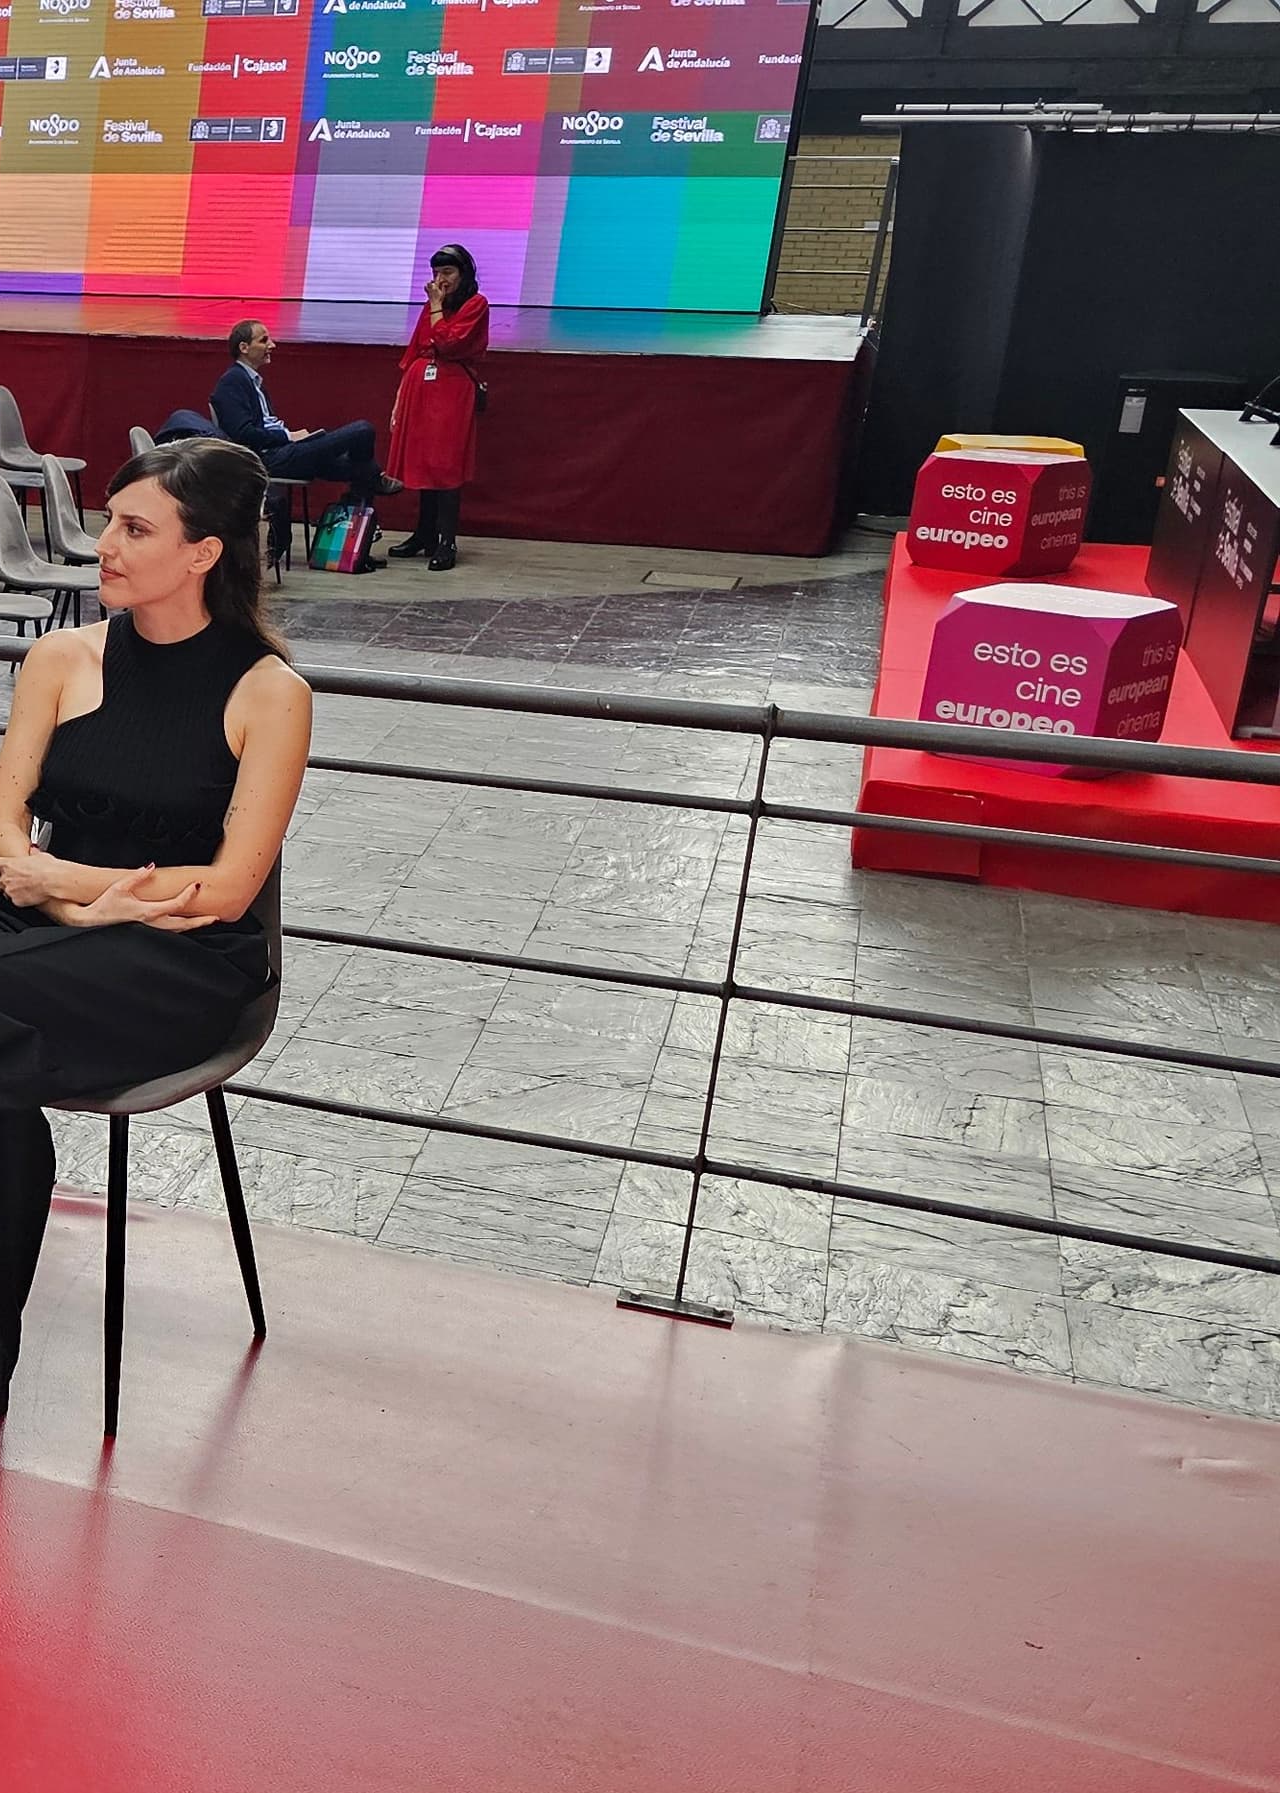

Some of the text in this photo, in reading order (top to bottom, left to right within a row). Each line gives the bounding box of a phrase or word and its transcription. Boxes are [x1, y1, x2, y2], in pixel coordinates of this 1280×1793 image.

[114, 7, 176, 19] de Sevilla
[407, 50, 458, 63] Festival
[668, 48, 697, 59] Junta
[113, 58, 137, 67] Junta
[187, 58, 287, 74] Fundación Cajasol
[405, 62, 474, 76] de Sevilla
[666, 57, 731, 68] de Andalucía
[113, 66, 165, 76] de Andalucía
[103, 119, 148, 132] Festival
[335, 120, 361, 130] Junta
[415, 122, 522, 139] Fundación Cajasol
[651, 116, 707, 131] Festival
[103, 131, 163, 143] de Sevilla
[334, 129, 390, 139] de Andalucía
[650, 129, 724, 143] de Sevilla
[942, 483, 1017, 504] esto es
[1058, 484, 1086, 501] this is
[969, 506, 1013, 527] cine
[1031, 507, 1082, 527] european
[916, 526, 1008, 549] europeo
[1041, 532, 1077, 550] cinema
[974, 642, 1088, 676] esto es
[1142, 640, 1175, 667] this is
[1016, 678, 1082, 707] cine
[1108, 674, 1168, 705] european
[935, 700, 1075, 736] europeo
[1116, 710, 1161, 737] cinema
